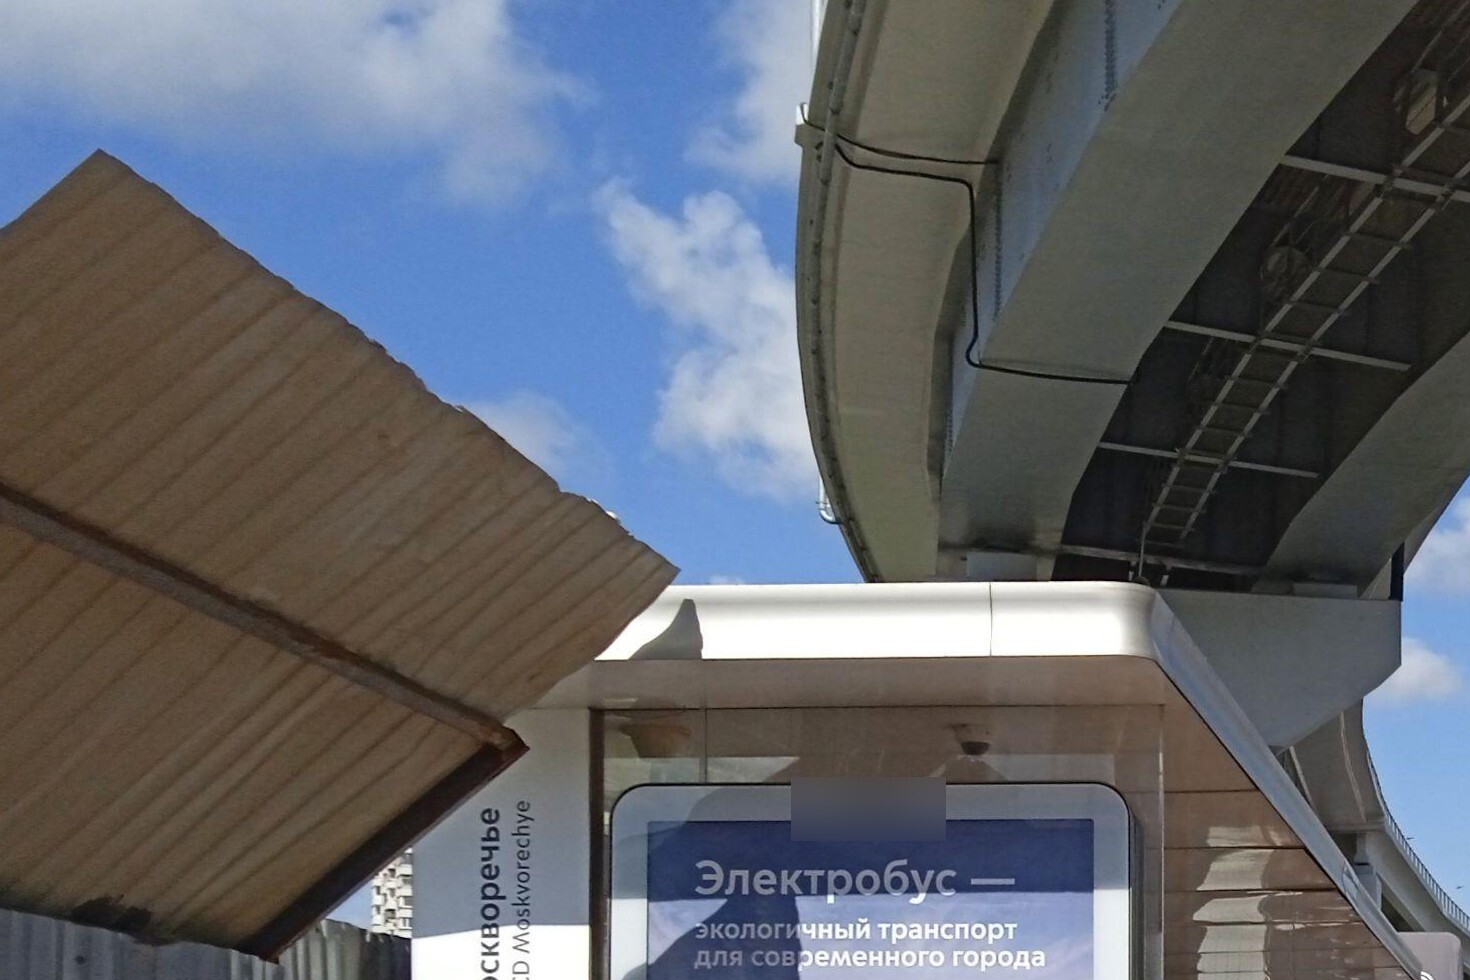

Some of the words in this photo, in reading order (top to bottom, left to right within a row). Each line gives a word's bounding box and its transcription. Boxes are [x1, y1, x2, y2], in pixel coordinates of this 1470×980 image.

[510, 799, 537, 955] Moskvorechye
[694, 859, 958, 905] Электробус
[694, 918, 871, 941] экологичный
[877, 921, 1018, 945] транспорт
[693, 948, 743, 970] для
[752, 948, 943, 970] современного
[952, 948, 1047, 971] города
